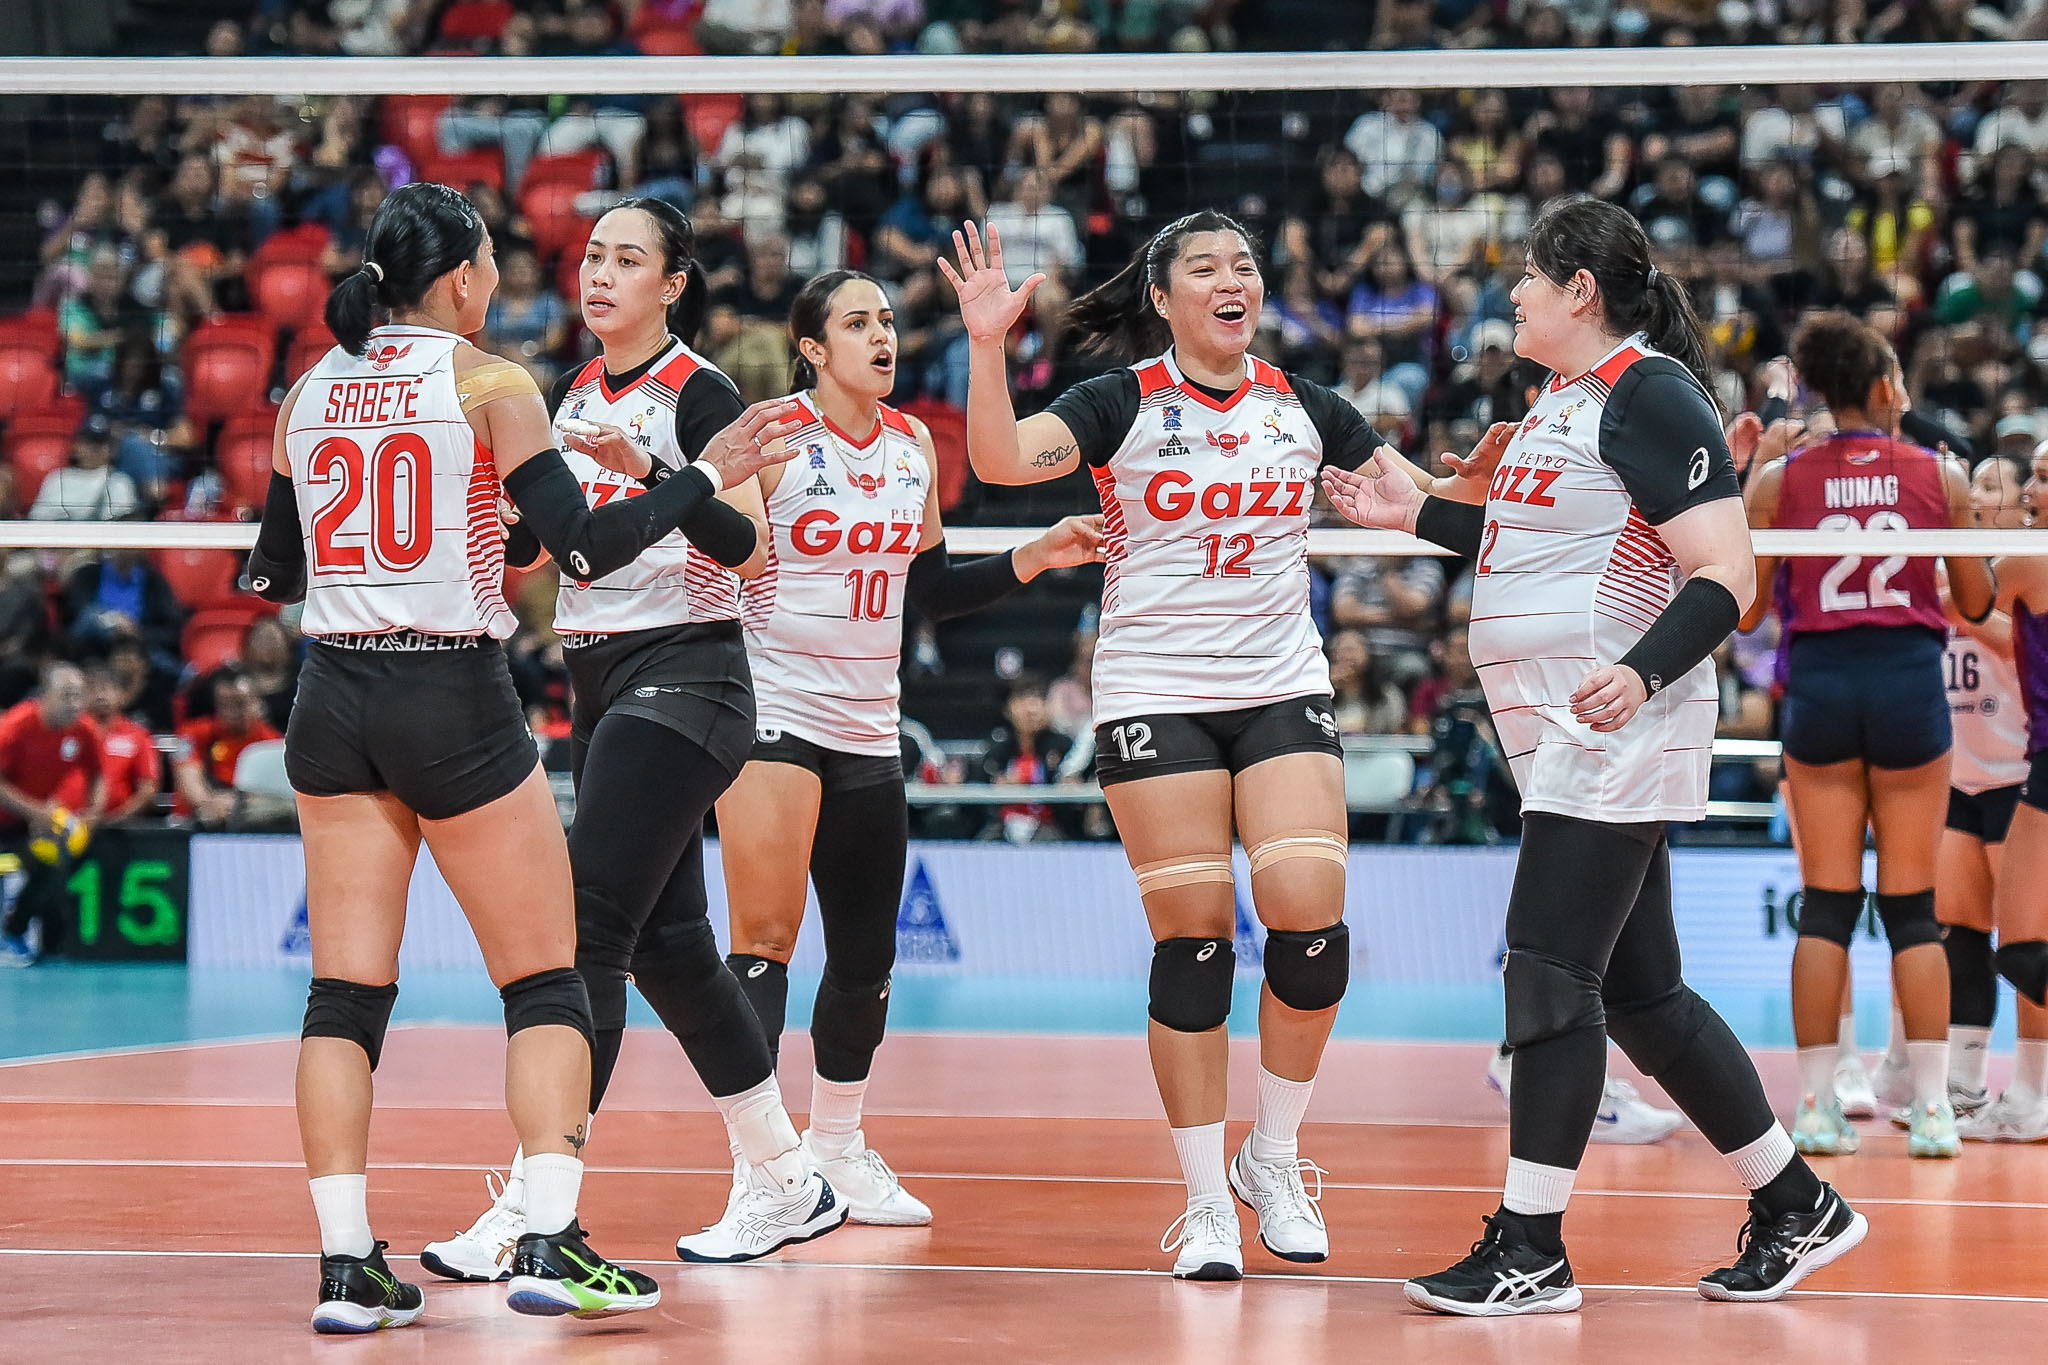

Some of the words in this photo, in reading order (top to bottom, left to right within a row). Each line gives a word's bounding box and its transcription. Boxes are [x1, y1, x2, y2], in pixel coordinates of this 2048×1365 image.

[324, 378, 422, 424] SABETE
[1159, 446, 1191, 457] DELTA
[1517, 451, 1568, 468] PETRO
[806, 486, 836, 496] DELTA
[1251, 467, 1308, 480] PETRO
[1824, 474, 1899, 508] NUNAG
[307, 432, 434, 577] 20
[1144, 469, 1313, 521] Gazz
[1198, 533, 1255, 579] 12
[1815, 510, 1911, 613] 22
[844, 568, 889, 622] 10
[405, 632, 479, 651] DELTA
[1948, 652, 1979, 691] 16
[1111, 722, 1157, 762] 12
[66, 858, 180, 945] 15
